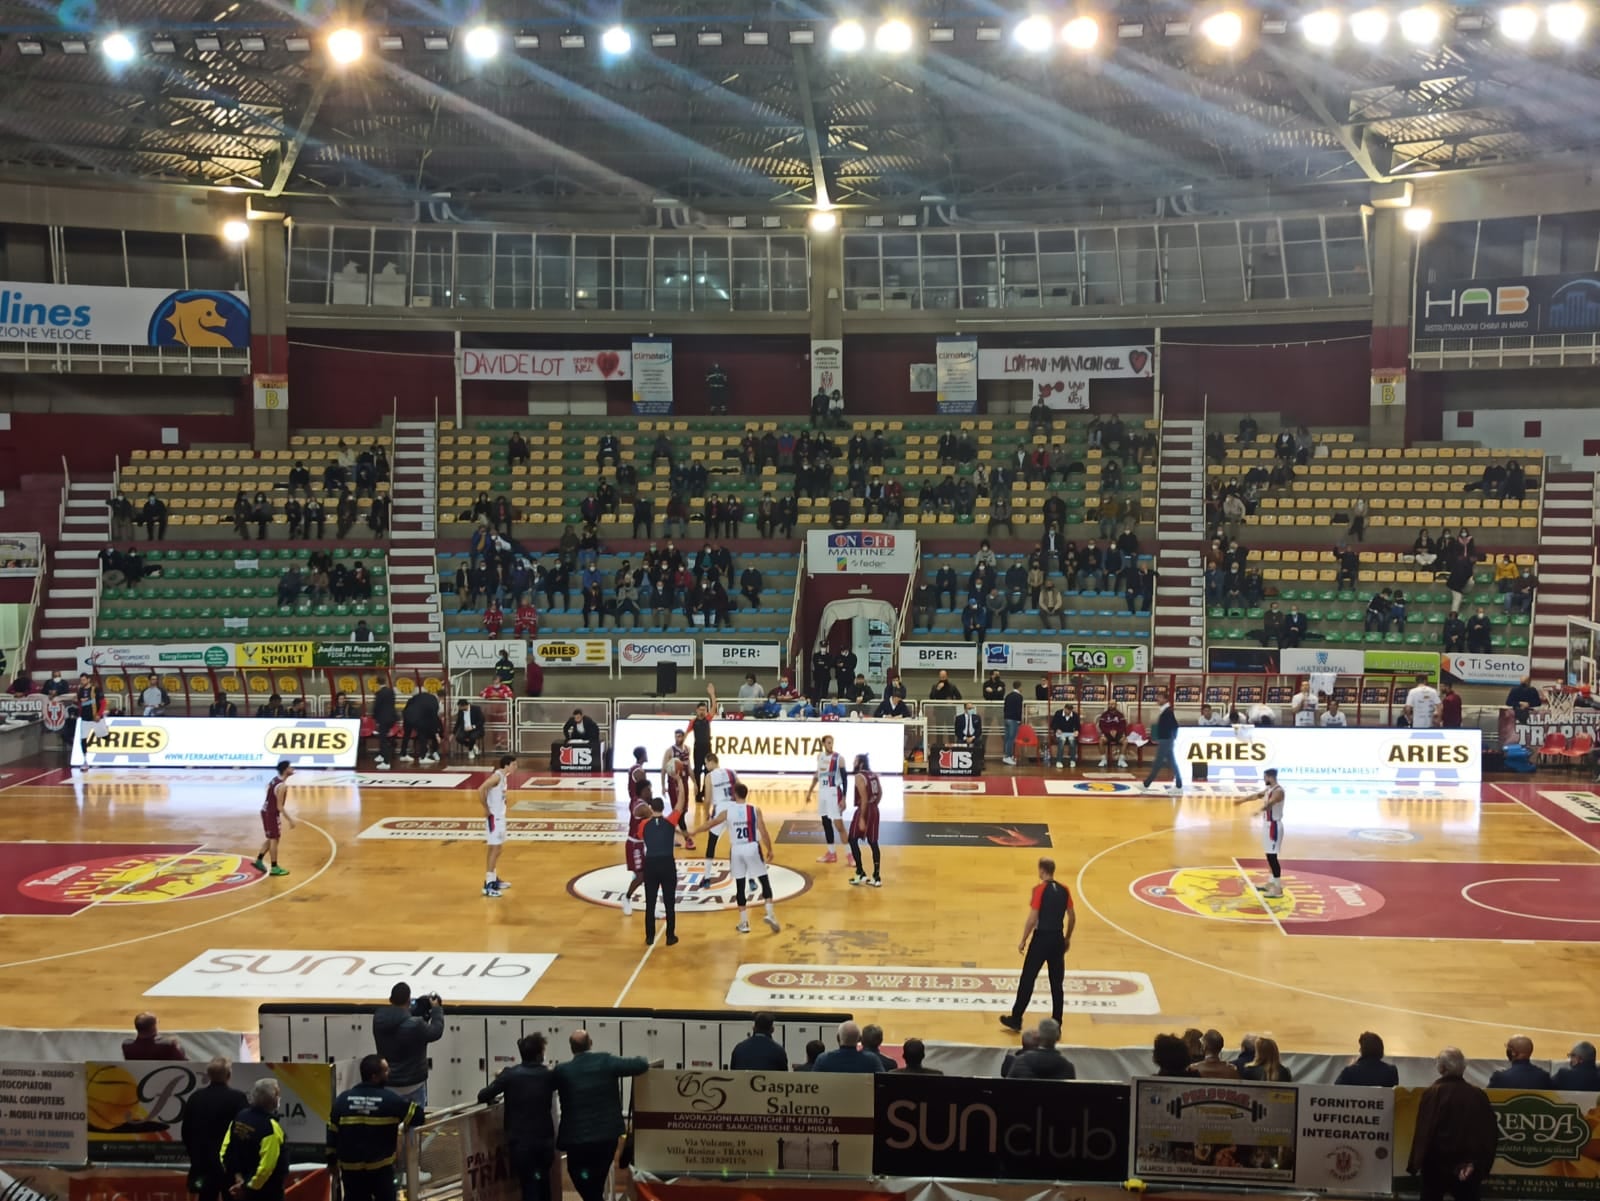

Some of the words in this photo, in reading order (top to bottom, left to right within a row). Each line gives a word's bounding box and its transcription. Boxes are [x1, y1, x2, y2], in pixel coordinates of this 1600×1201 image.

[1425, 285, 1530, 318] HAB
[41, 328, 92, 340] VELOCE
[265, 390, 279, 408] B
[1382, 385, 1395, 403] B
[828, 548, 895, 556] MARTINEZ
[261, 644, 308, 654] ISOTTO
[541, 646, 576, 655] ARIES
[261, 655, 305, 664] SPORT
[1469, 658, 1481, 670] Ti
[1485, 659, 1525, 672] Sento
[87, 731, 161, 749] ARIES
[272, 732, 348, 749] ARIES
[1187, 742, 1267, 761] ARIES
[1388, 744, 1470, 763] ARIES
[736, 827, 750, 839] 20
[766, 972, 858, 986] OLD
[865, 974, 984, 989] WILD
[750, 1074, 820, 1097] Gaspare
[19, 1095, 65, 1106] COMPUTERS
[767, 1096, 831, 1116] Salerno
[1309, 1096, 1385, 1111] FORNITORE
[9, 1110, 37, 1120] MOBILI
[39, 1111, 53, 1120] PER
[55, 1112, 86, 1121] UFFICIO
[673, 1113, 732, 1122] LAVORAZIONI
[734, 1115, 784, 1124] ARTISTICHE
[786, 1116, 796, 1124] IN
[798, 1116, 826, 1125] FERRO
[828, 1117, 833, 1125] E
[1312, 1112, 1381, 1126] UFFICIALE
[667, 1121, 724, 1131] PRODUZIONE
[726, 1123, 792, 1133] SARACINESCHE
[794, 1124, 806, 1133] SU
[807, 1125, 840, 1134] MISURA
[1302, 1127, 1390, 1142] INTEGRATORI
[684, 1138, 698, 1147] Via
